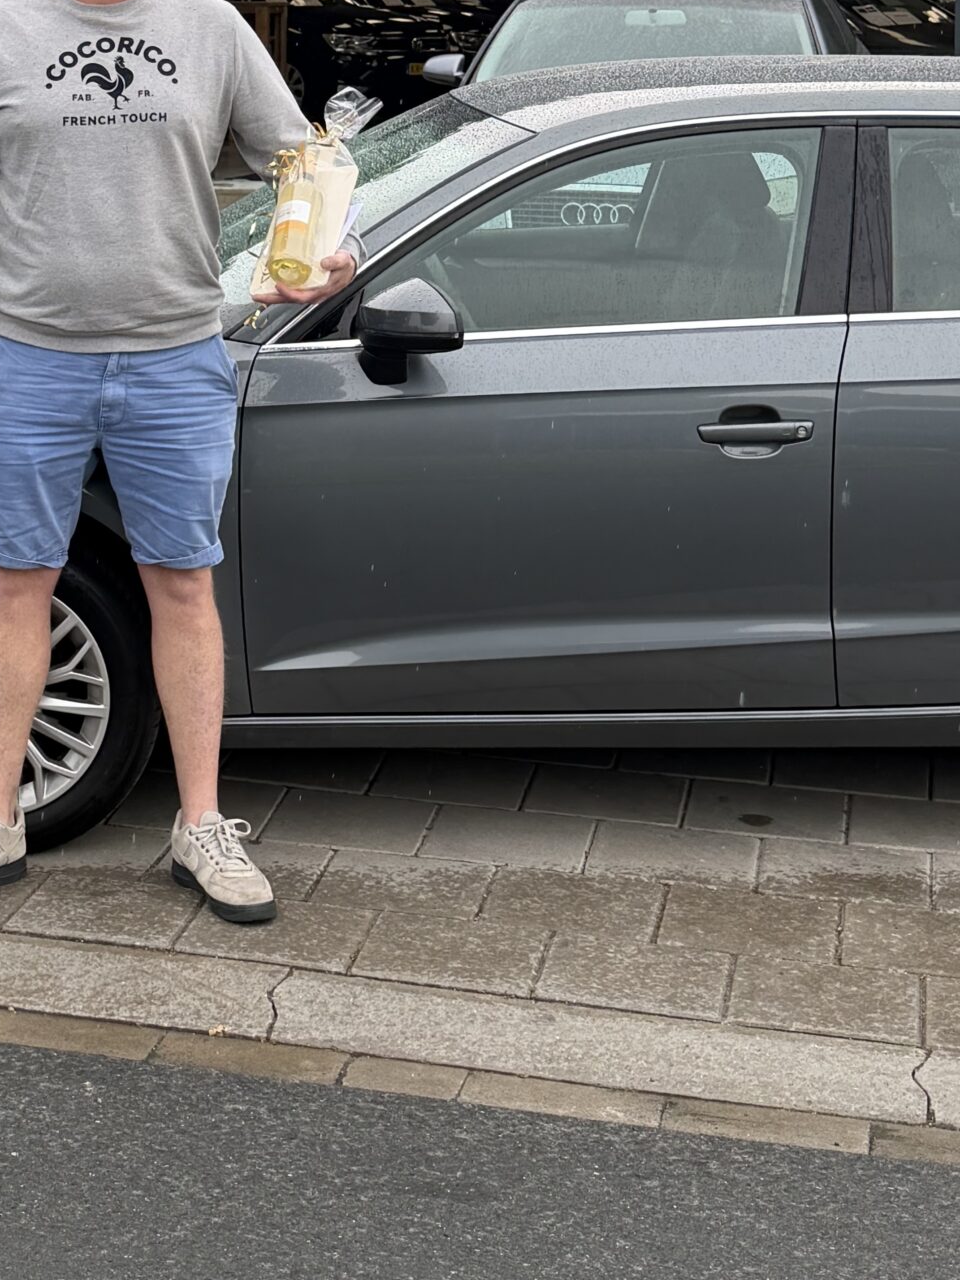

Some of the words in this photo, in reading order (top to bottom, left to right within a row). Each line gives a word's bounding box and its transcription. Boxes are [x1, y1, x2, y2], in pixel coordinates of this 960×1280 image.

[71, 93, 95, 101] FAB.
[137, 89, 154, 98] FR.
[62, 115, 116, 126] FRENCH
[120, 112, 167, 123] TOUCH
